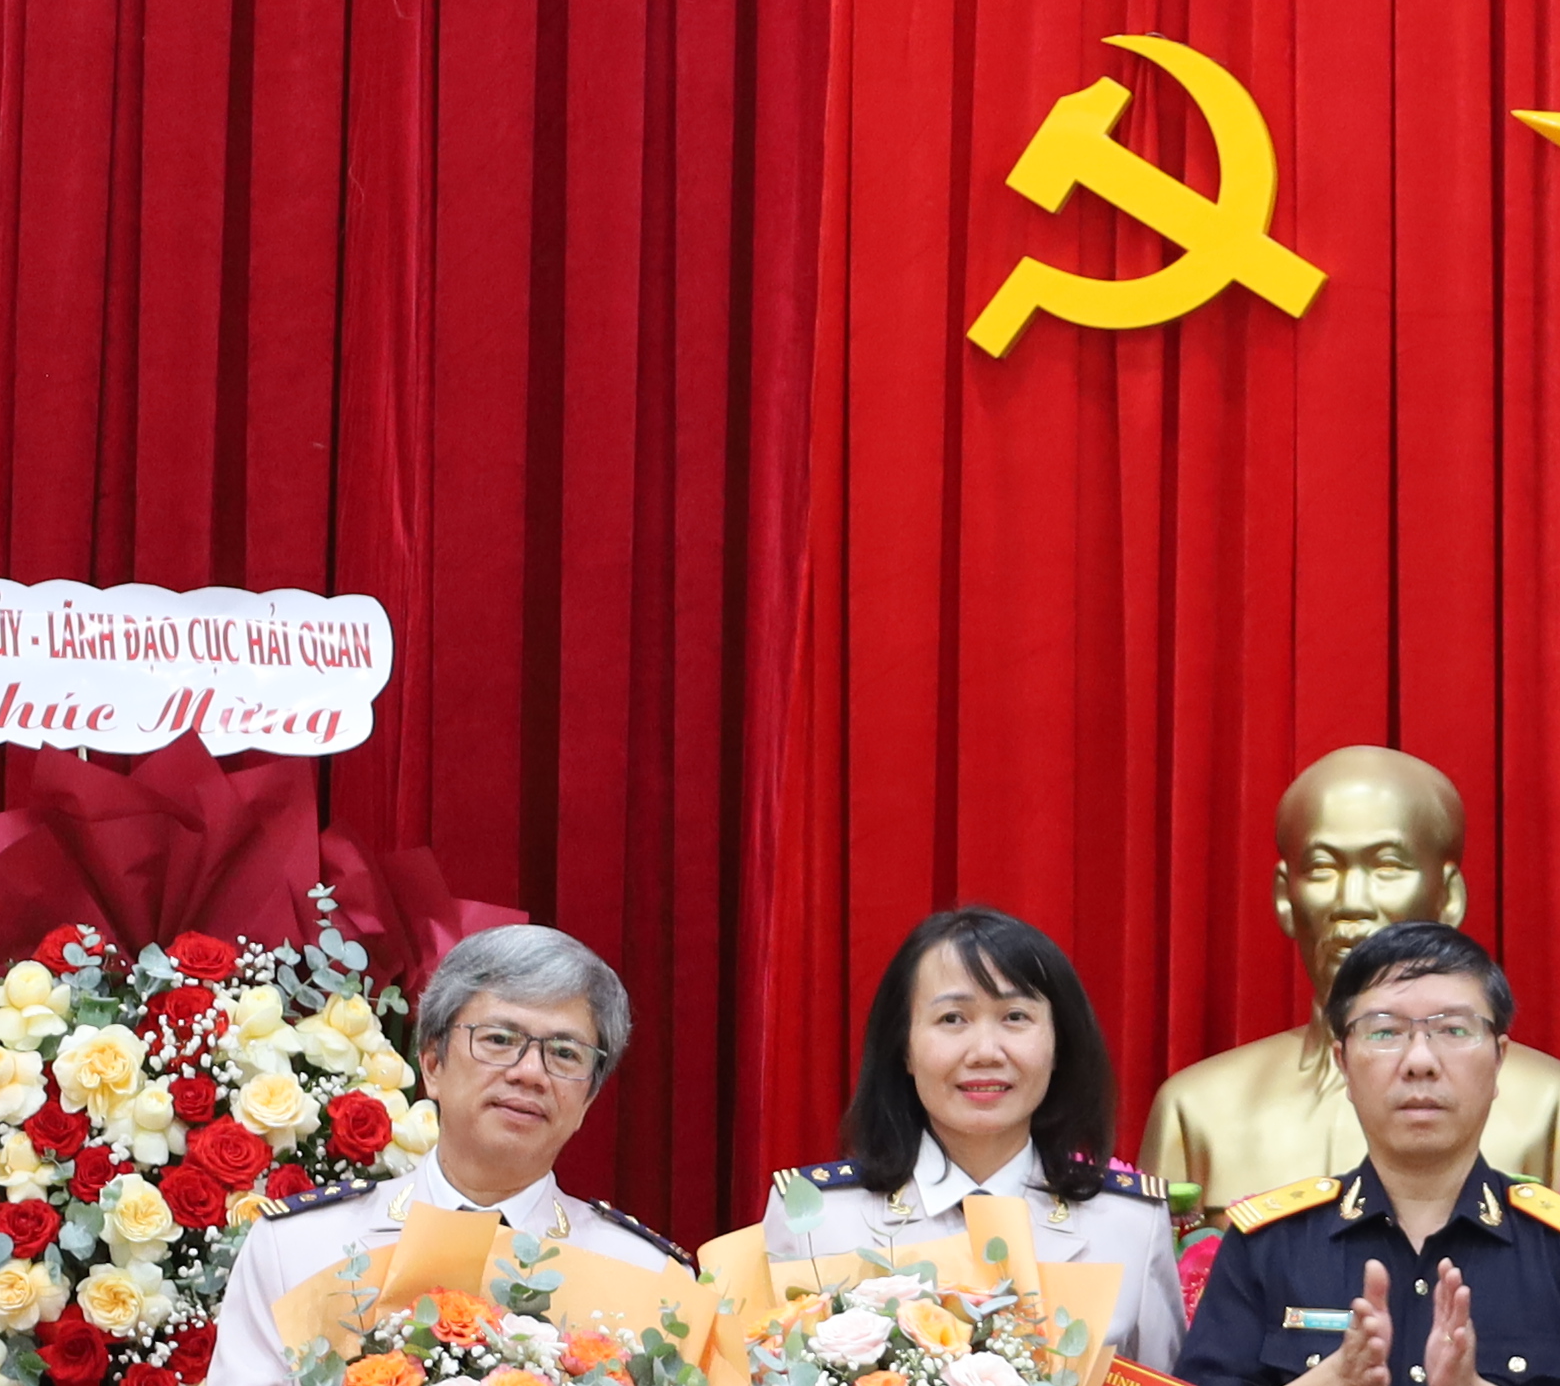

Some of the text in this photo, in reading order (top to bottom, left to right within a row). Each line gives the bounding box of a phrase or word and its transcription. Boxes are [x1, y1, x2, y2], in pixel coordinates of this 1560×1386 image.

[46, 599, 118, 661] LÃNH
[124, 614, 179, 674] ĐẠO
[187, 616, 241, 675] CỤC
[246, 602, 293, 667] HẢI
[297, 620, 374, 674] QUAN
[136, 686, 350, 744] Mừng
